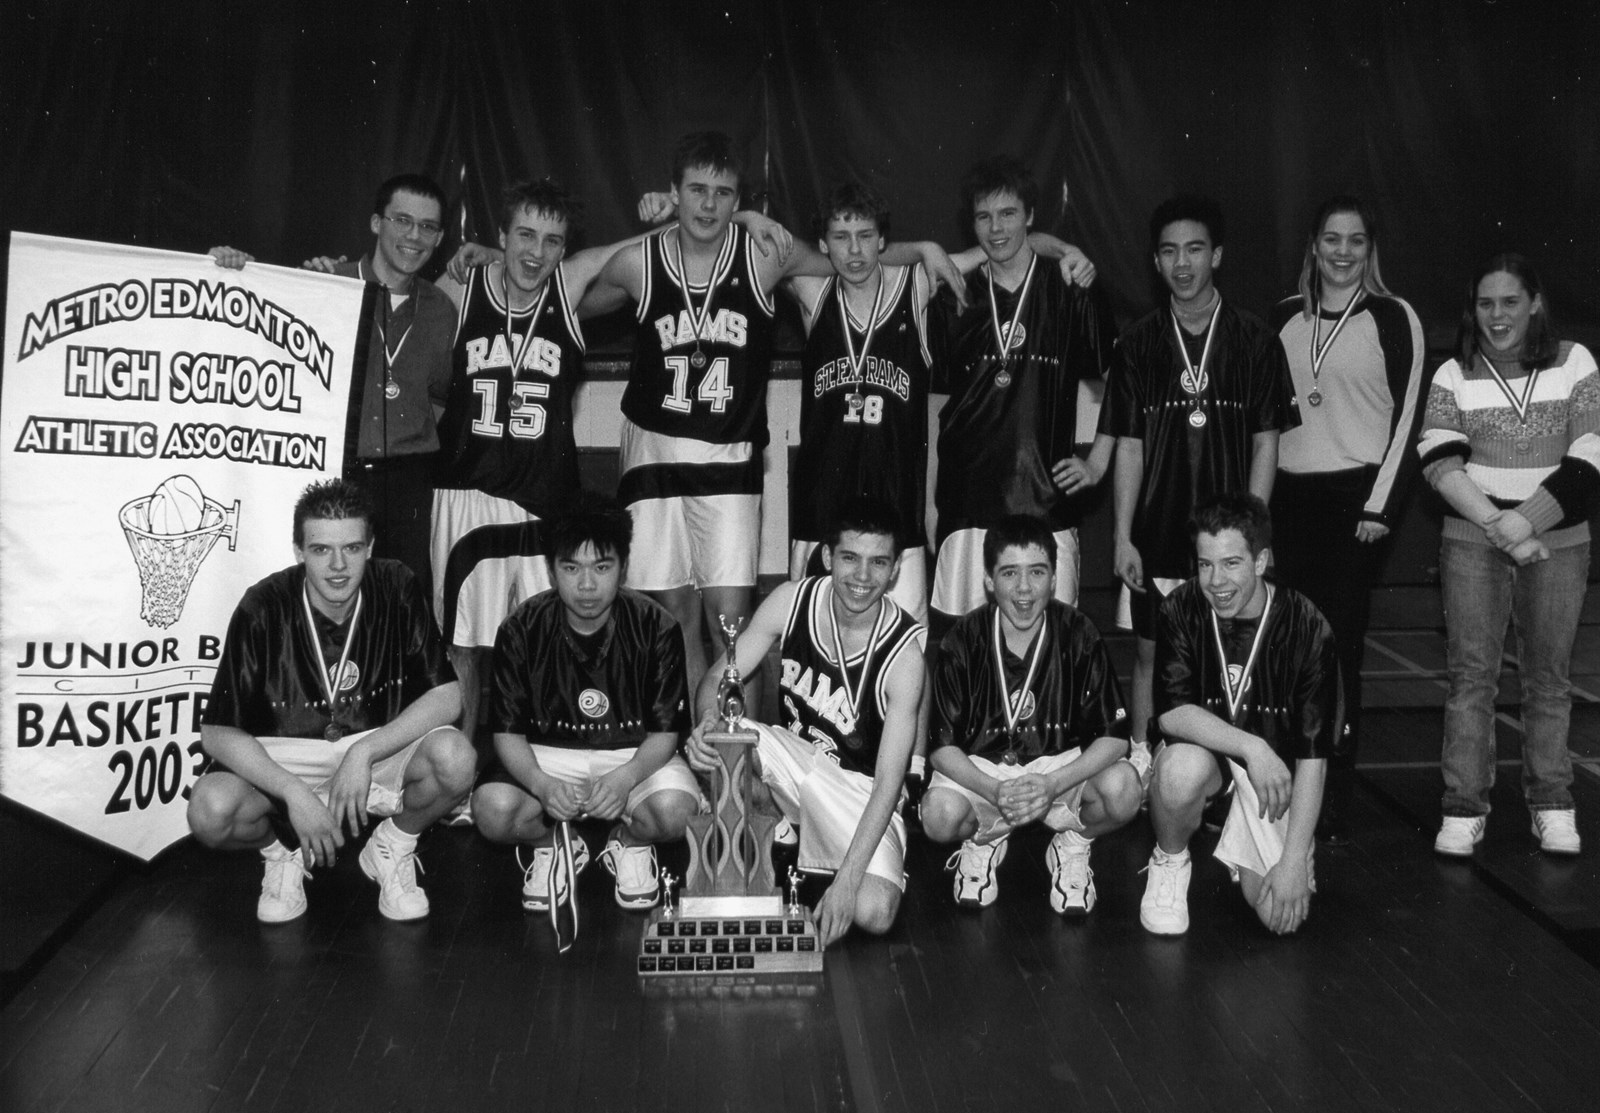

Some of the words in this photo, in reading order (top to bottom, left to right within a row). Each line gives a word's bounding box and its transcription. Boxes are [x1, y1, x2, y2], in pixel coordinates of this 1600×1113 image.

[17, 279, 149, 363] METRO
[150, 278, 334, 391] EDMONTON
[466, 333, 561, 377] RAMS
[654, 308, 747, 352] RAMS
[65, 345, 161, 401] HIGH
[169, 351, 302, 413] SCHOOL
[661, 356, 733, 413] 14
[866, 356, 909, 401] RAMS
[472, 379, 550, 439] 15
[843, 393, 884, 425] 18
[14, 415, 158, 459] ATHLETIC
[160, 423, 327, 471] ASSOCIATION
[17, 638, 180, 670] JUNIOR
[54, 670, 201, 692] CIT
[304, 695, 362, 708] FRACIS
[780, 658, 860, 735] RAMS
[105, 740, 208, 815] 2003
